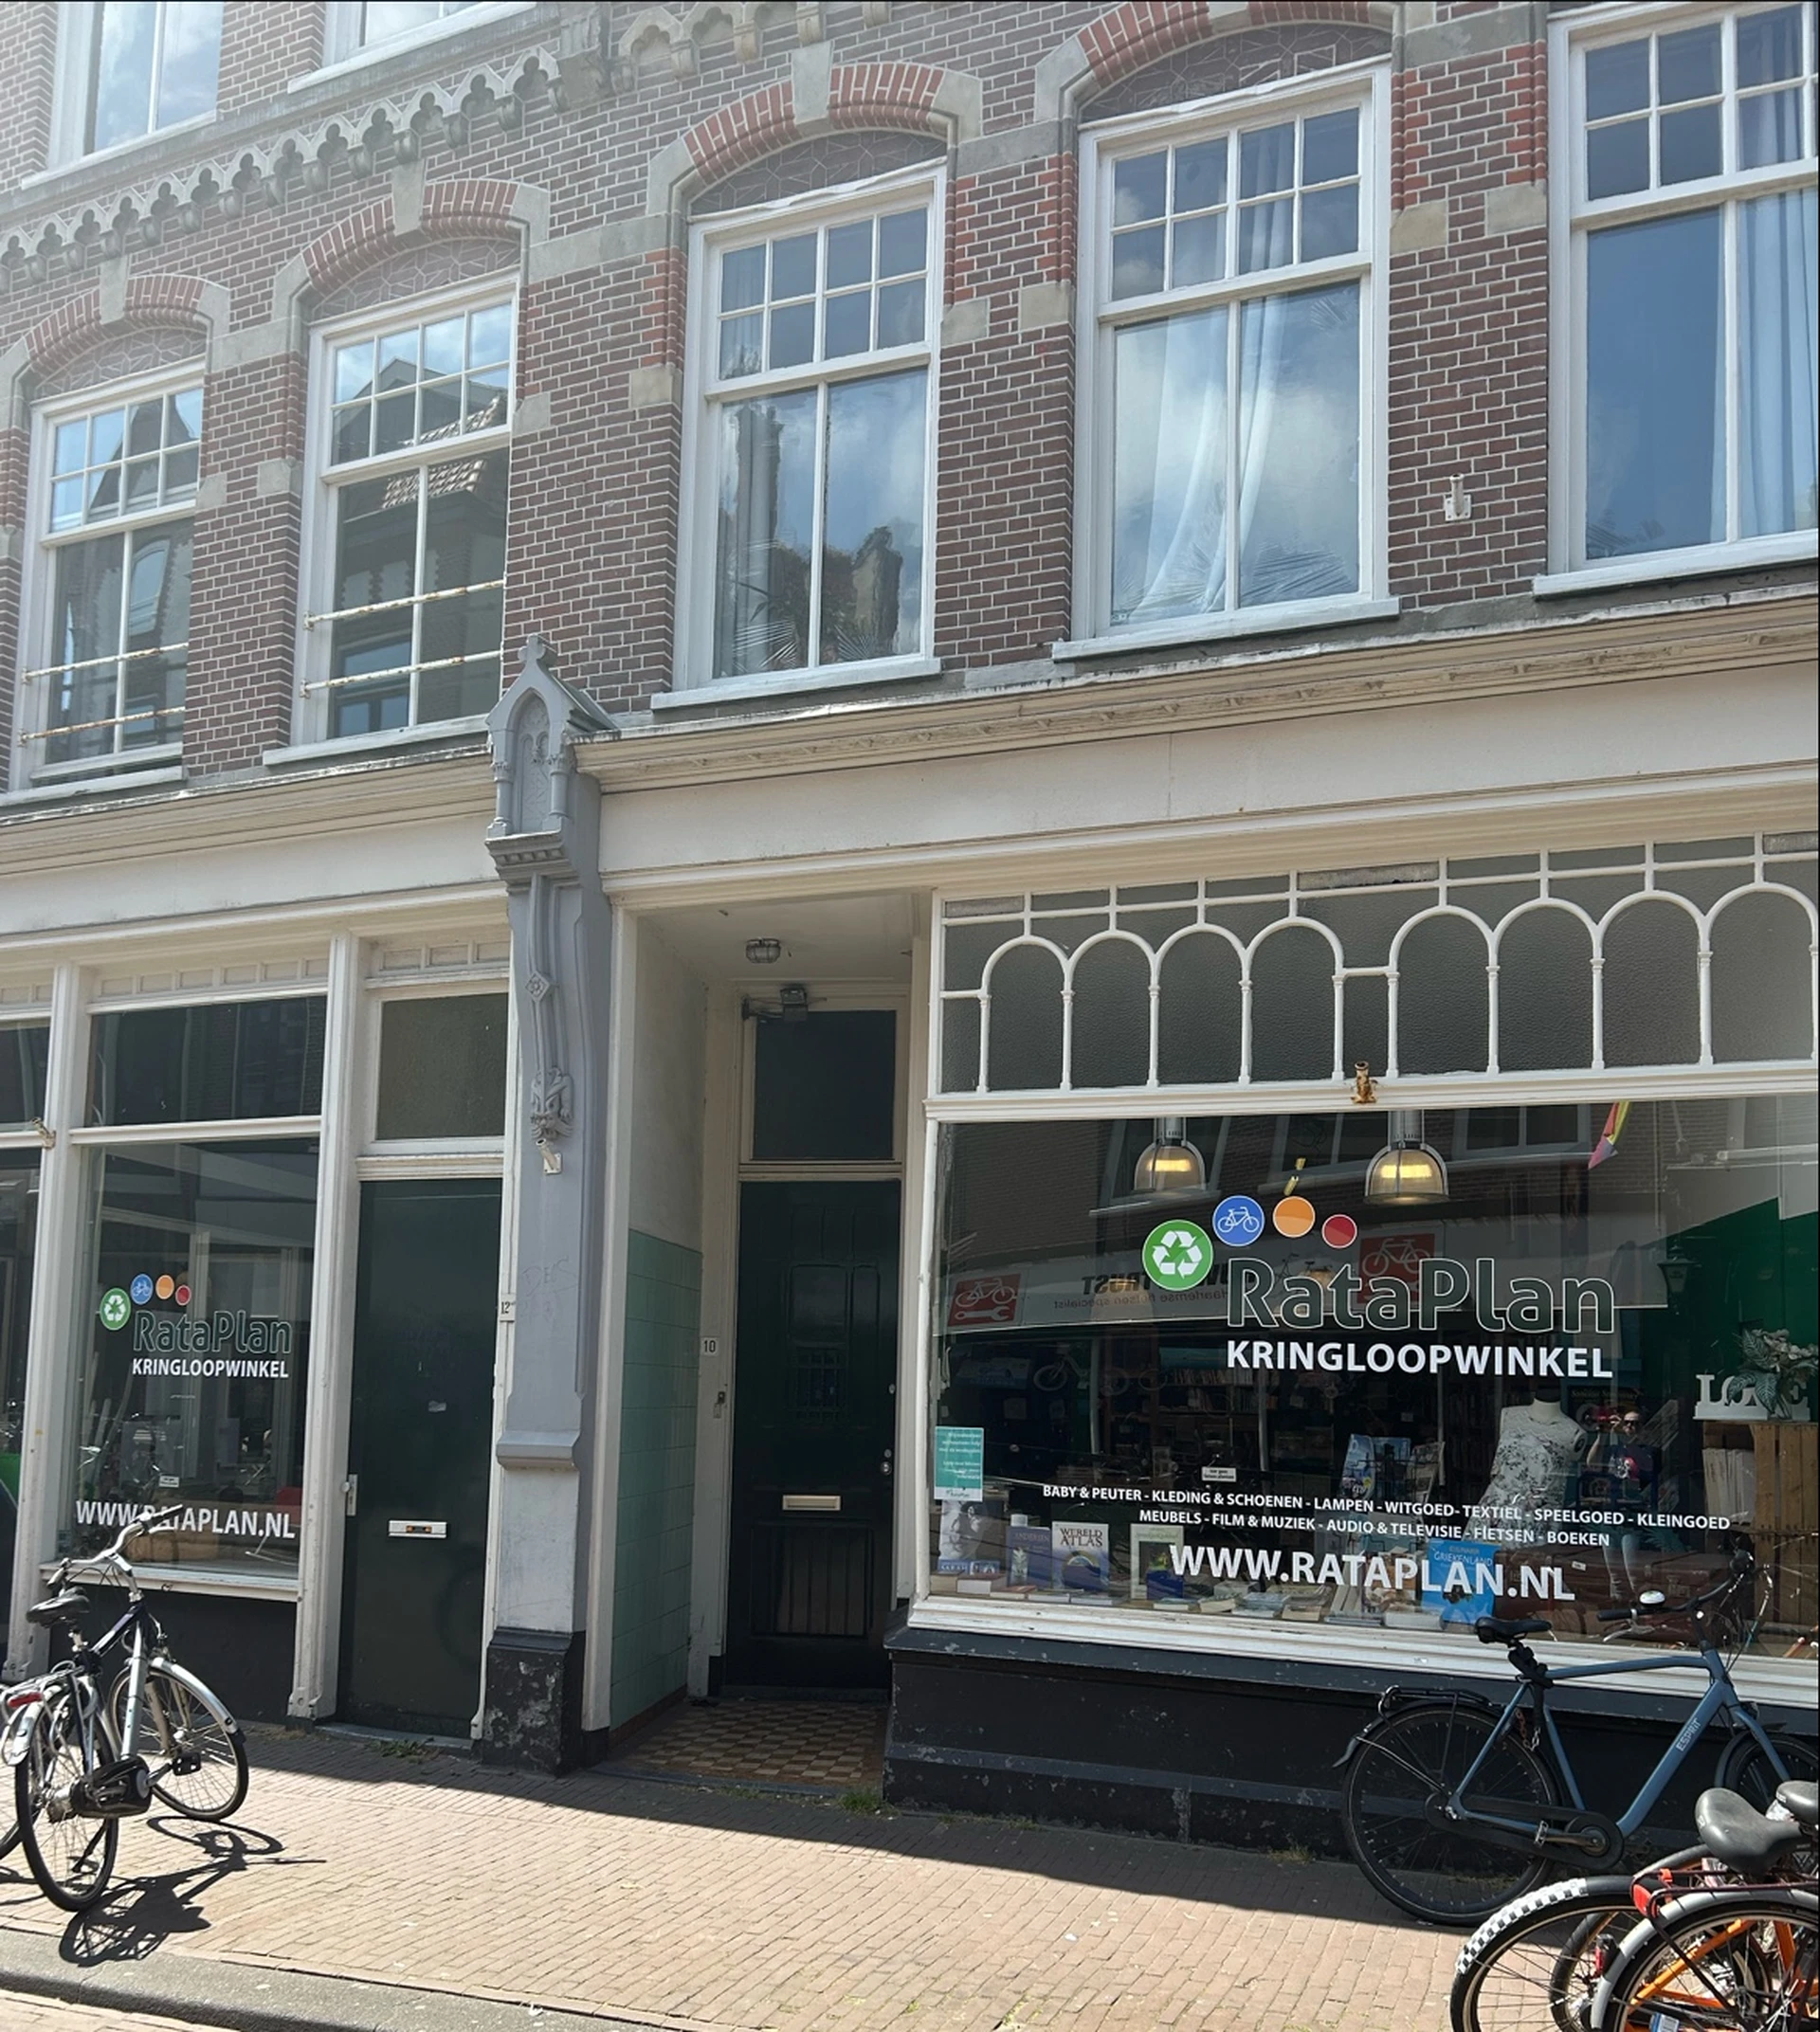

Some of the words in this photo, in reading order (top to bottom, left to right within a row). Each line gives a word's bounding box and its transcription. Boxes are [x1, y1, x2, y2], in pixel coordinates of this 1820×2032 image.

[1227, 1257, 1614, 1334] RataPlan
[133, 1309, 292, 1354] RataPlan
[704, 1339, 716, 1353] 10
[132, 1357, 289, 1378] KRINGLOOPWINKEL
[1227, 1340, 1613, 1379] KRINGLOOPWINKEL
[1043, 1485, 1078, 1497] BABY
[1079, 1486, 1090, 1498] &
[1092, 1487, 1142, 1501] PEUTER
[1152, 1490, 1210, 1504] KLEDING
[1213, 1493, 1225, 1505] &
[1227, 1493, 1302, 1508] SCHOENEN
[1314, 1497, 1374, 1513] LAMPEN
[1462, 1504, 1521, 1520] TEXTIEL
[1534, 1508, 1625, 1525] SPEELGOED
[1637, 1513, 1731, 1530] KLEINGOED
[1060, 1527, 1103, 1538] WERELD
[1060, 1535, 1103, 1548] ATLAS
[1139, 1509, 1202, 1525] MEUBELS
[1212, 1513, 1245, 1526] FILM
[1247, 1515, 1259, 1527] &
[1261, 1515, 1316, 1531] MUZIEK
[1326, 1519, 1375, 1533] AUDIO
[1376, 1521, 1388, 1534] &
[1390, 1522, 1462, 1538] TELEVISIE
[1473, 1526, 1535, 1543] FIETSEN
[1547, 1531, 1610, 1547] BOEKEN
[1168, 1544, 1576, 1602] WWW.RATAPLAN.NL
[1675, 1716, 1702, 1752] ESPRIT
